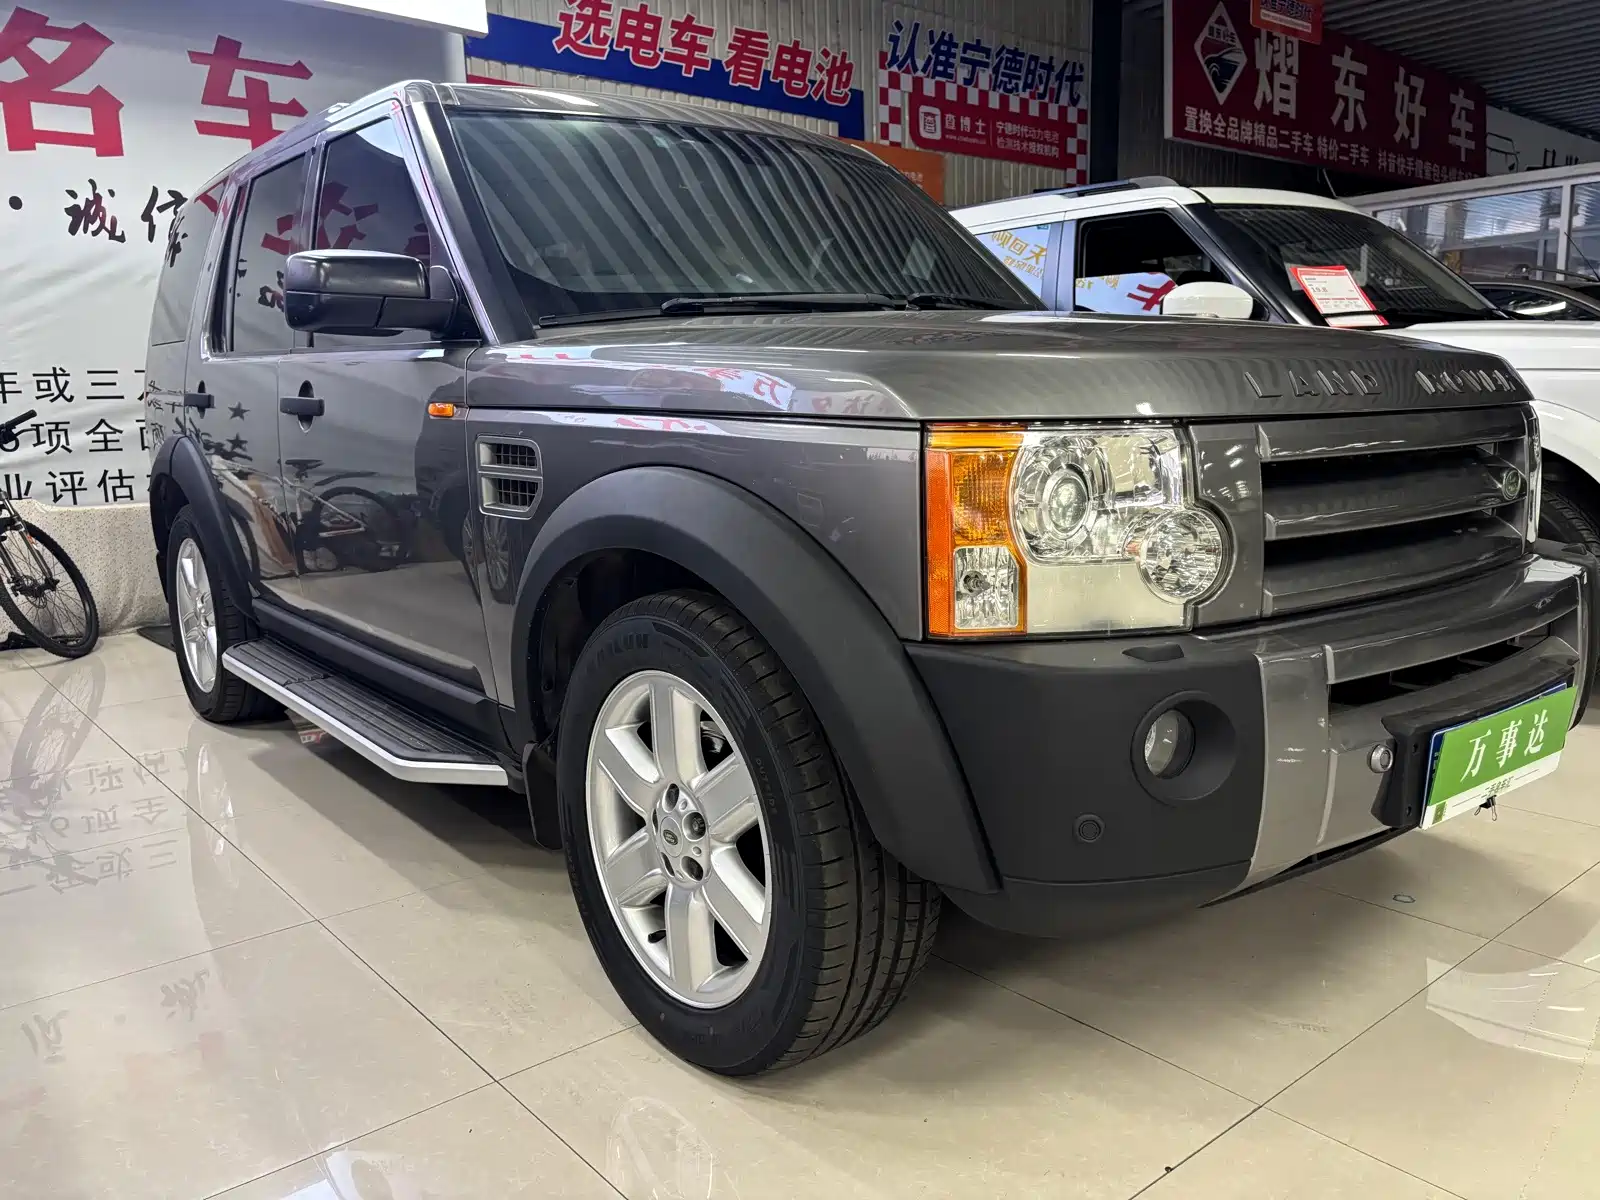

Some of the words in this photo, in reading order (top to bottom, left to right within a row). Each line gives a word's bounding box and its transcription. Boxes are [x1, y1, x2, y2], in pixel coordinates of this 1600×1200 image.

[552, 0, 715, 77] 选电车
[723, 26, 856, 107] 看电池
[886, 19, 1086, 107] 认准宁德时代
[1184, 105, 1314, 157] 置换全品牌精品二手车
[1317, 135, 1371, 168] 特价二手车
[1244, 369, 1383, 398] LAND
[1460, 709, 1549, 783] 万事达
